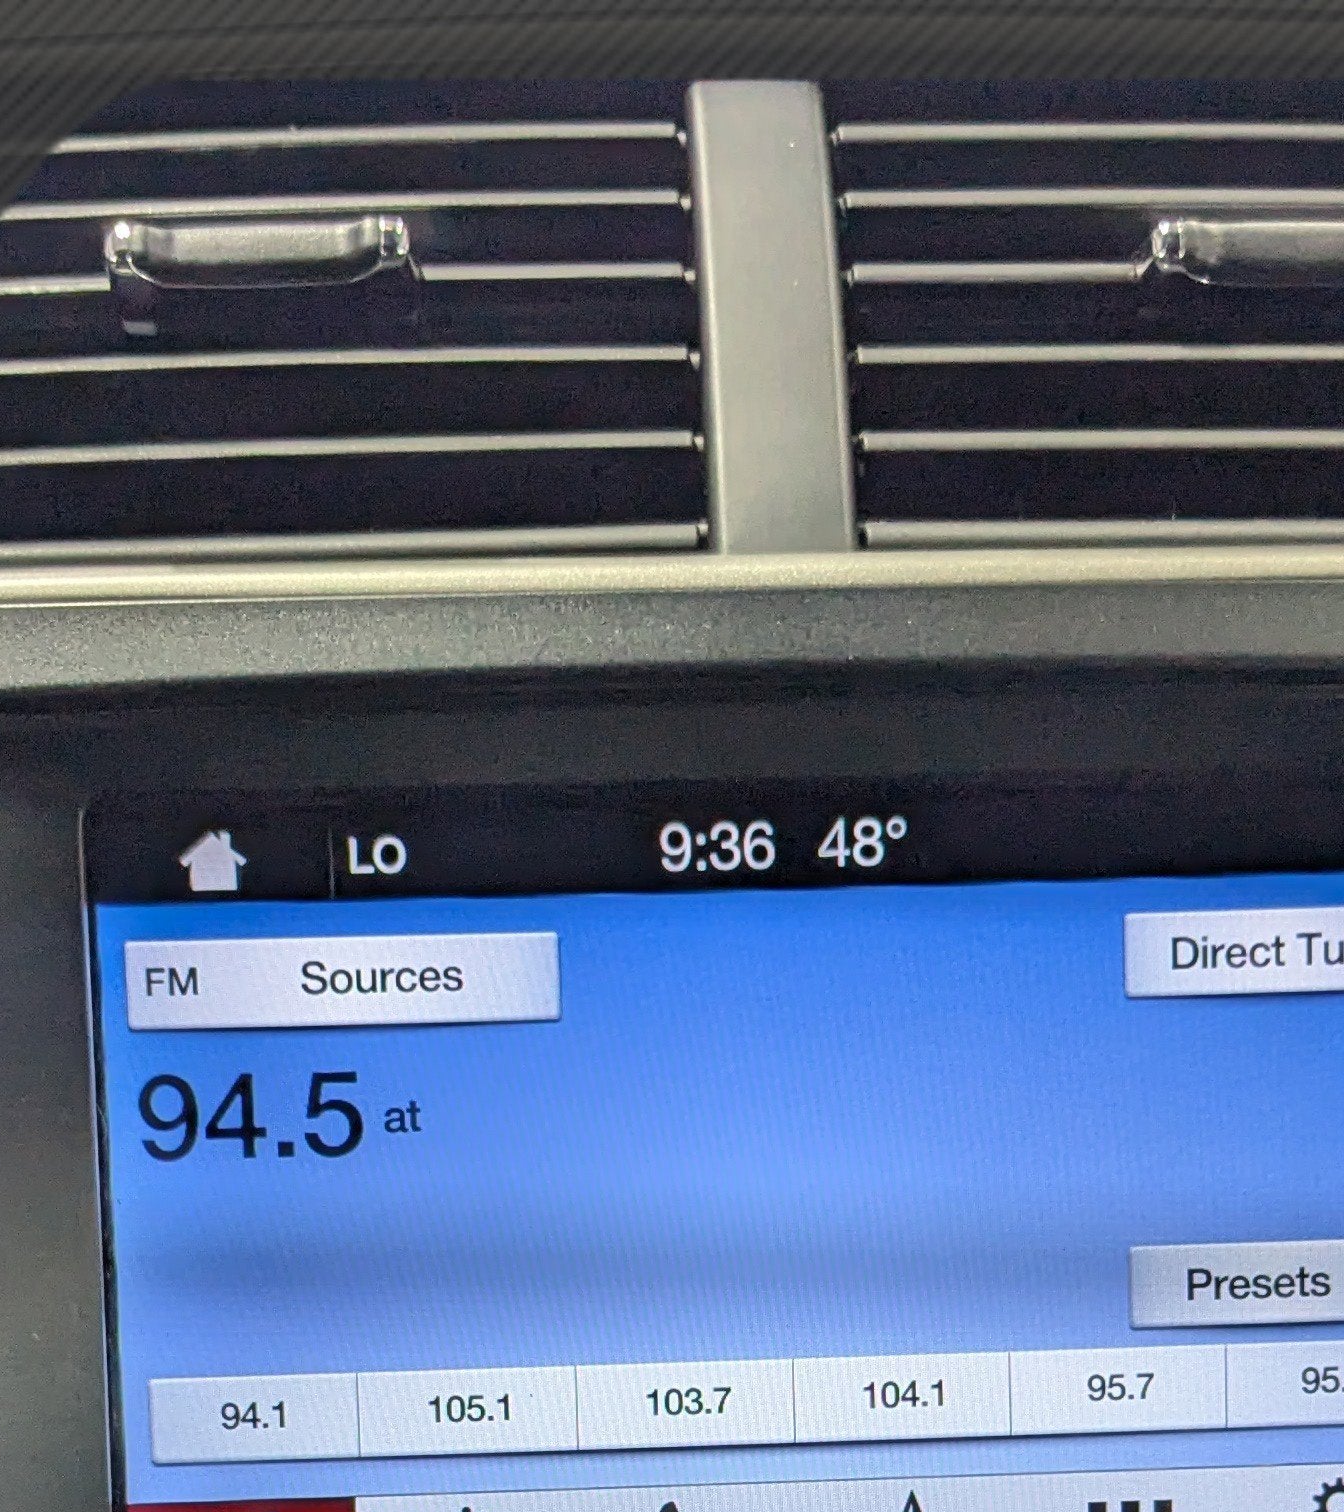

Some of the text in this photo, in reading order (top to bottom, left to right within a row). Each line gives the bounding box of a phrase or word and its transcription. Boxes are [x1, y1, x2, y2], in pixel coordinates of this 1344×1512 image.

[348, 834, 408, 876] LO
[658, 815, 908, 872] 9:36 48°
[1170, 935, 1286, 970] Direct
[144, 966, 199, 997] FM
[300, 961, 464, 995] Sources
[137, 1071, 422, 1162] 94.5 at
[1186, 1266, 1332, 1302] Presets
[646, 1386, 732, 1417] 103.7
[863, 1379, 946, 1409] 104.1
[1087, 1373, 1155, 1402] 95.7
[220, 1400, 287, 1430] 94.1
[428, 1393, 512, 1424] 105.1
